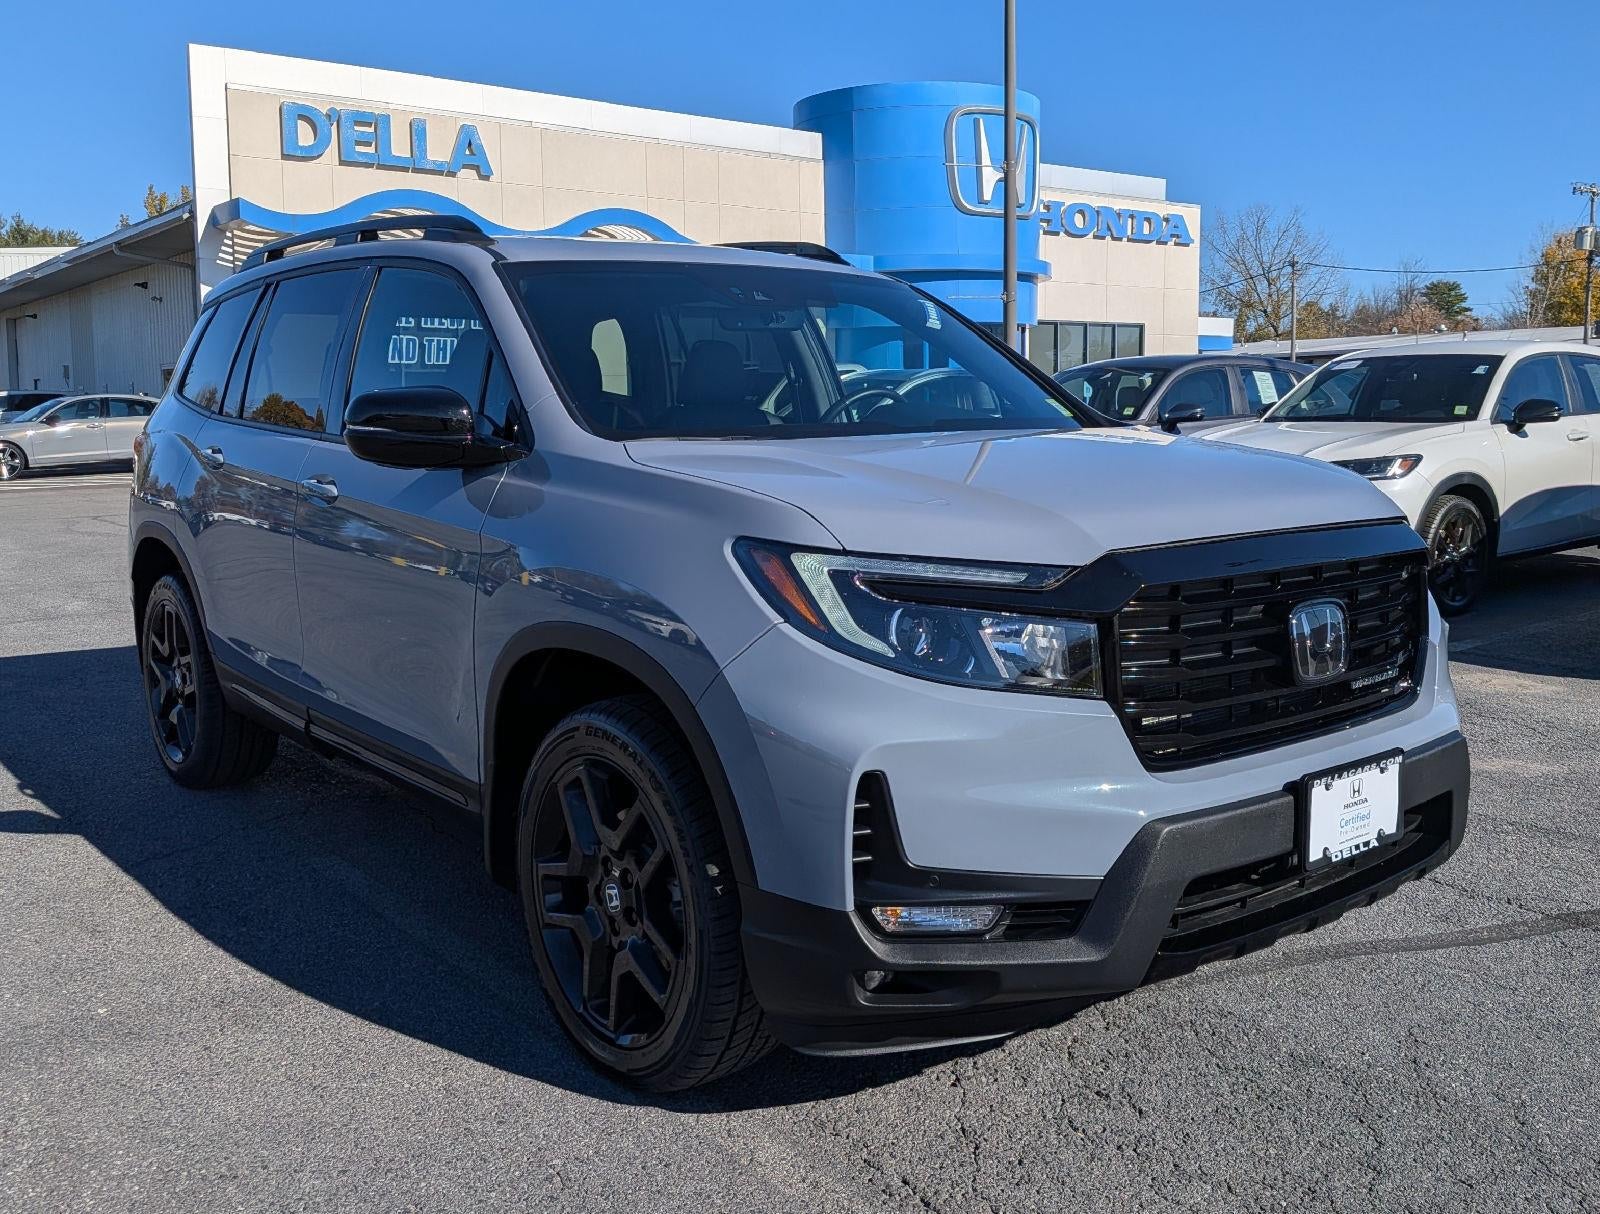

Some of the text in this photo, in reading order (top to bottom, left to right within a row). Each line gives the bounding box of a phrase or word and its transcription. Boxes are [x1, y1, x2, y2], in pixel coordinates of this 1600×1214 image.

[280, 101, 494, 181] D'ELLA
[1040, 199, 1194, 247] HONDA
[1313, 755, 1403, 788] DELLACARS.COM
[1342, 797, 1369, 811] HONDA
[1339, 810, 1371, 829] Certified
[1331, 838, 1379, 862] DELLA
